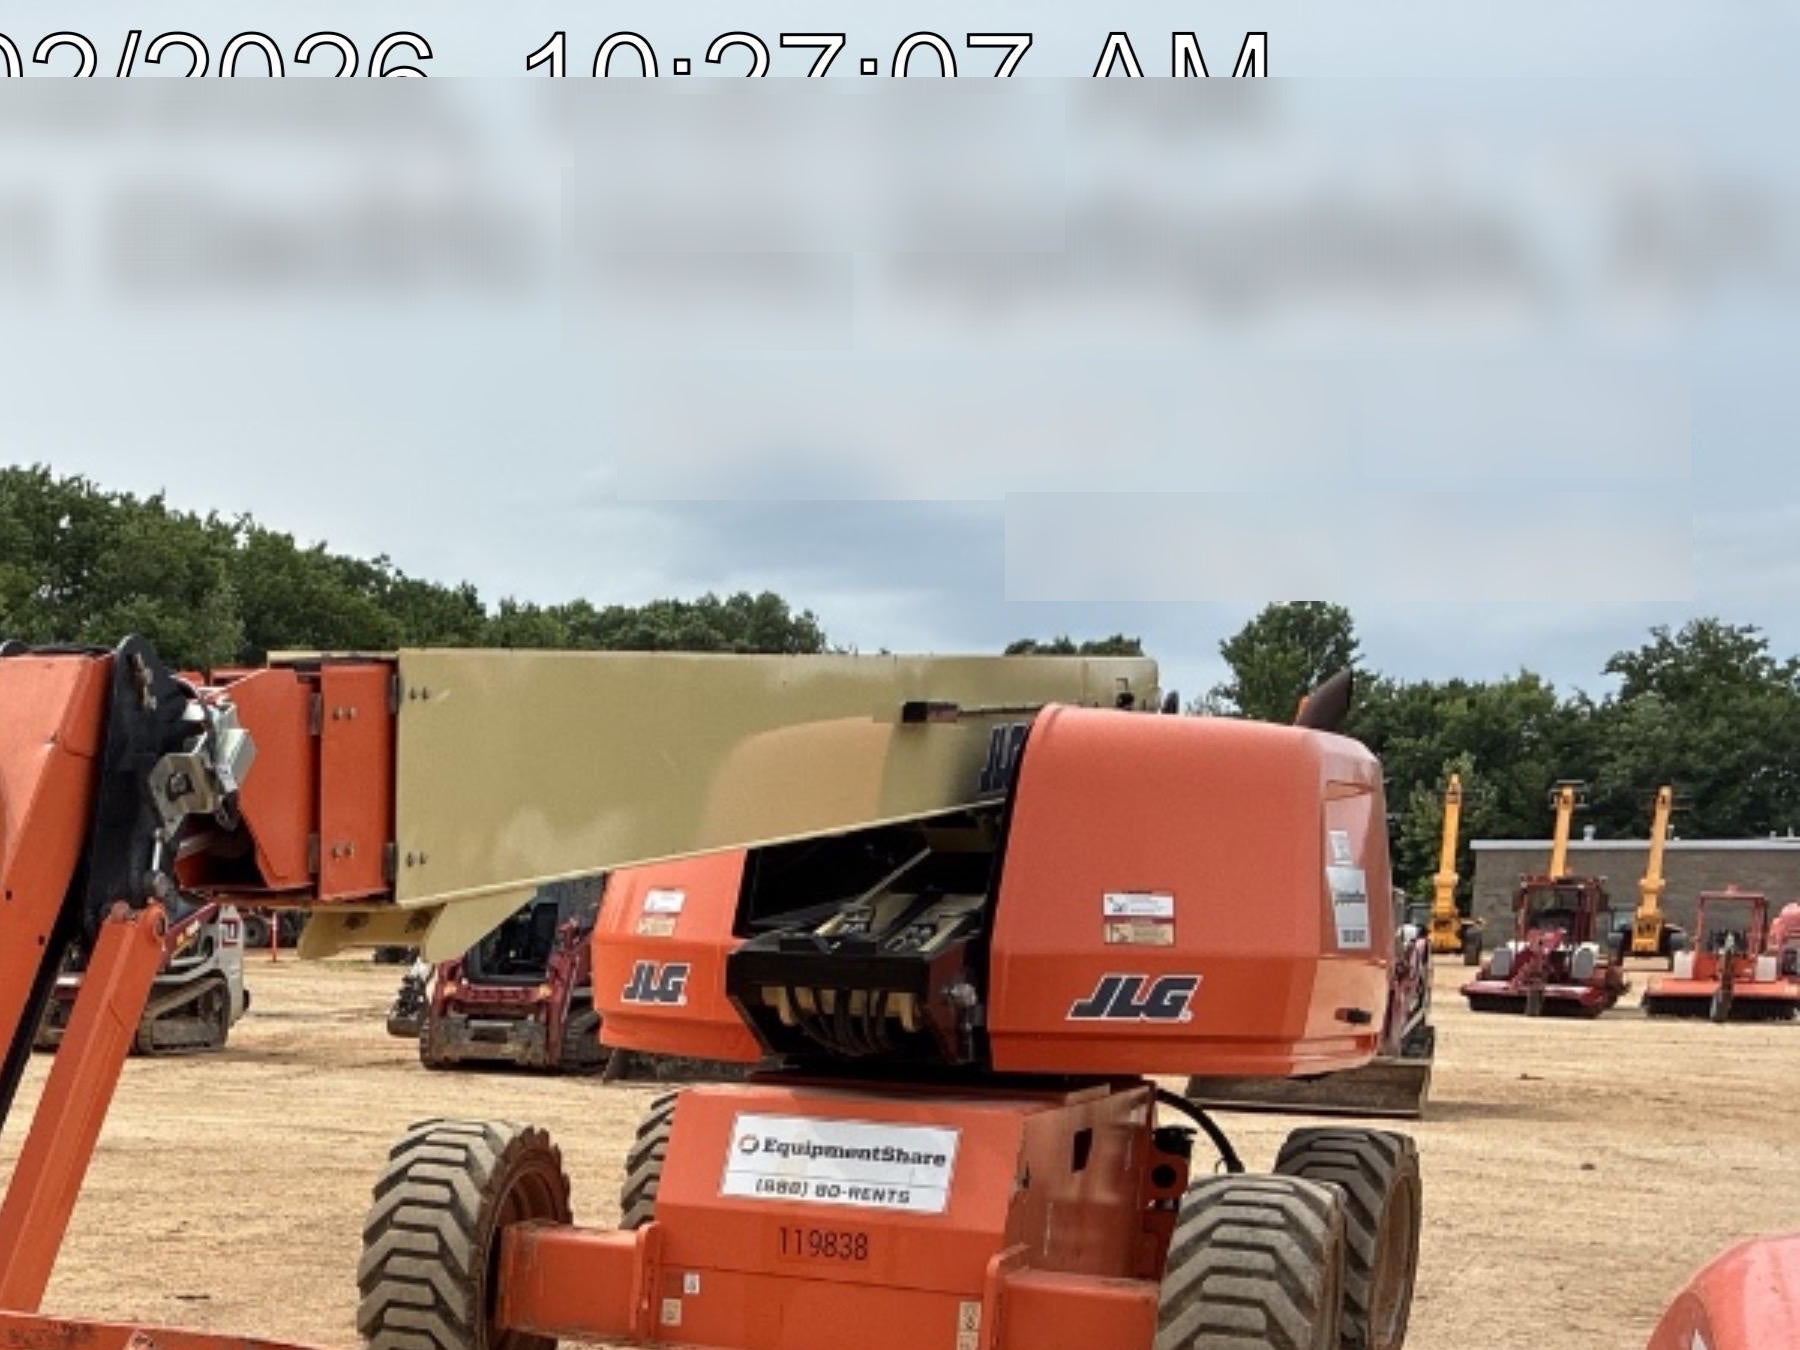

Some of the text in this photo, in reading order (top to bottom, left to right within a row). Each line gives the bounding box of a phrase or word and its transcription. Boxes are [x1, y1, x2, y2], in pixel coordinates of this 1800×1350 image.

[621, 960, 691, 1005] JLG
[1066, 973, 1203, 1022] JLG
[762, 1136, 947, 1167] EquipmentShare
[779, 1226, 869, 1261] 119838
